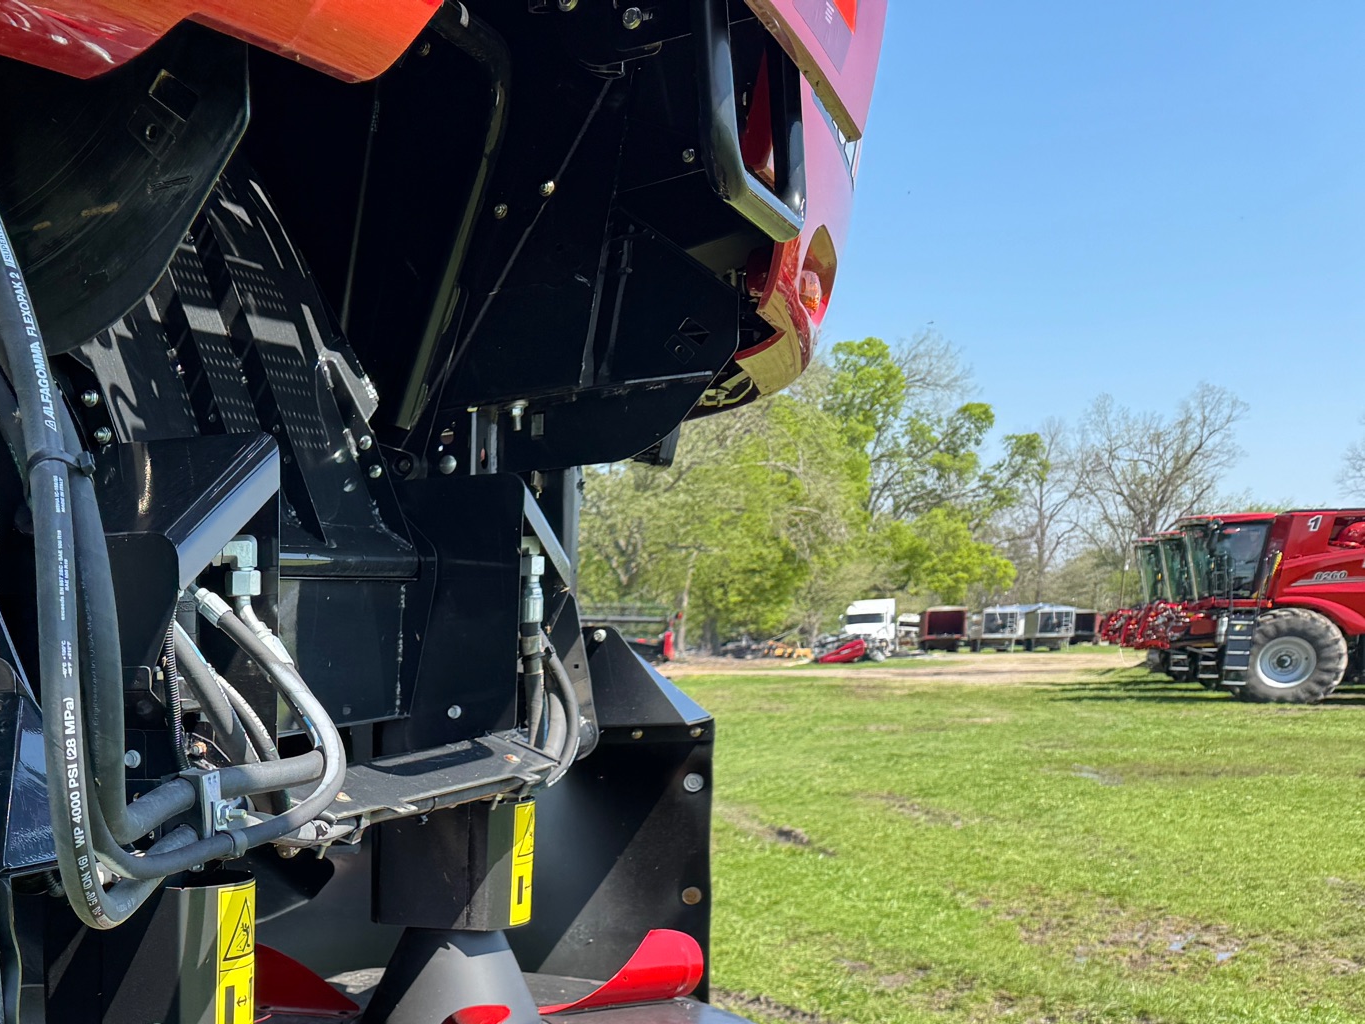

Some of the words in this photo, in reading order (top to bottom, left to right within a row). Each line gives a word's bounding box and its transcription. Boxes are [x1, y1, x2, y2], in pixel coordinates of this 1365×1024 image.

[9, 271, 21, 280] 2
[15, 281, 38, 338] FLEXOPAK
[33, 342, 55, 421] ALFAGOMMA
[1307, 515, 1323, 531] 1
[1314, 570, 1347, 581] 8260
[63, 697, 75, 735] MPa)
[65, 739, 78, 761] (28
[67, 764, 81, 789] PSI
[70, 791, 83, 825] 4000
[73, 832, 86, 849] WP
